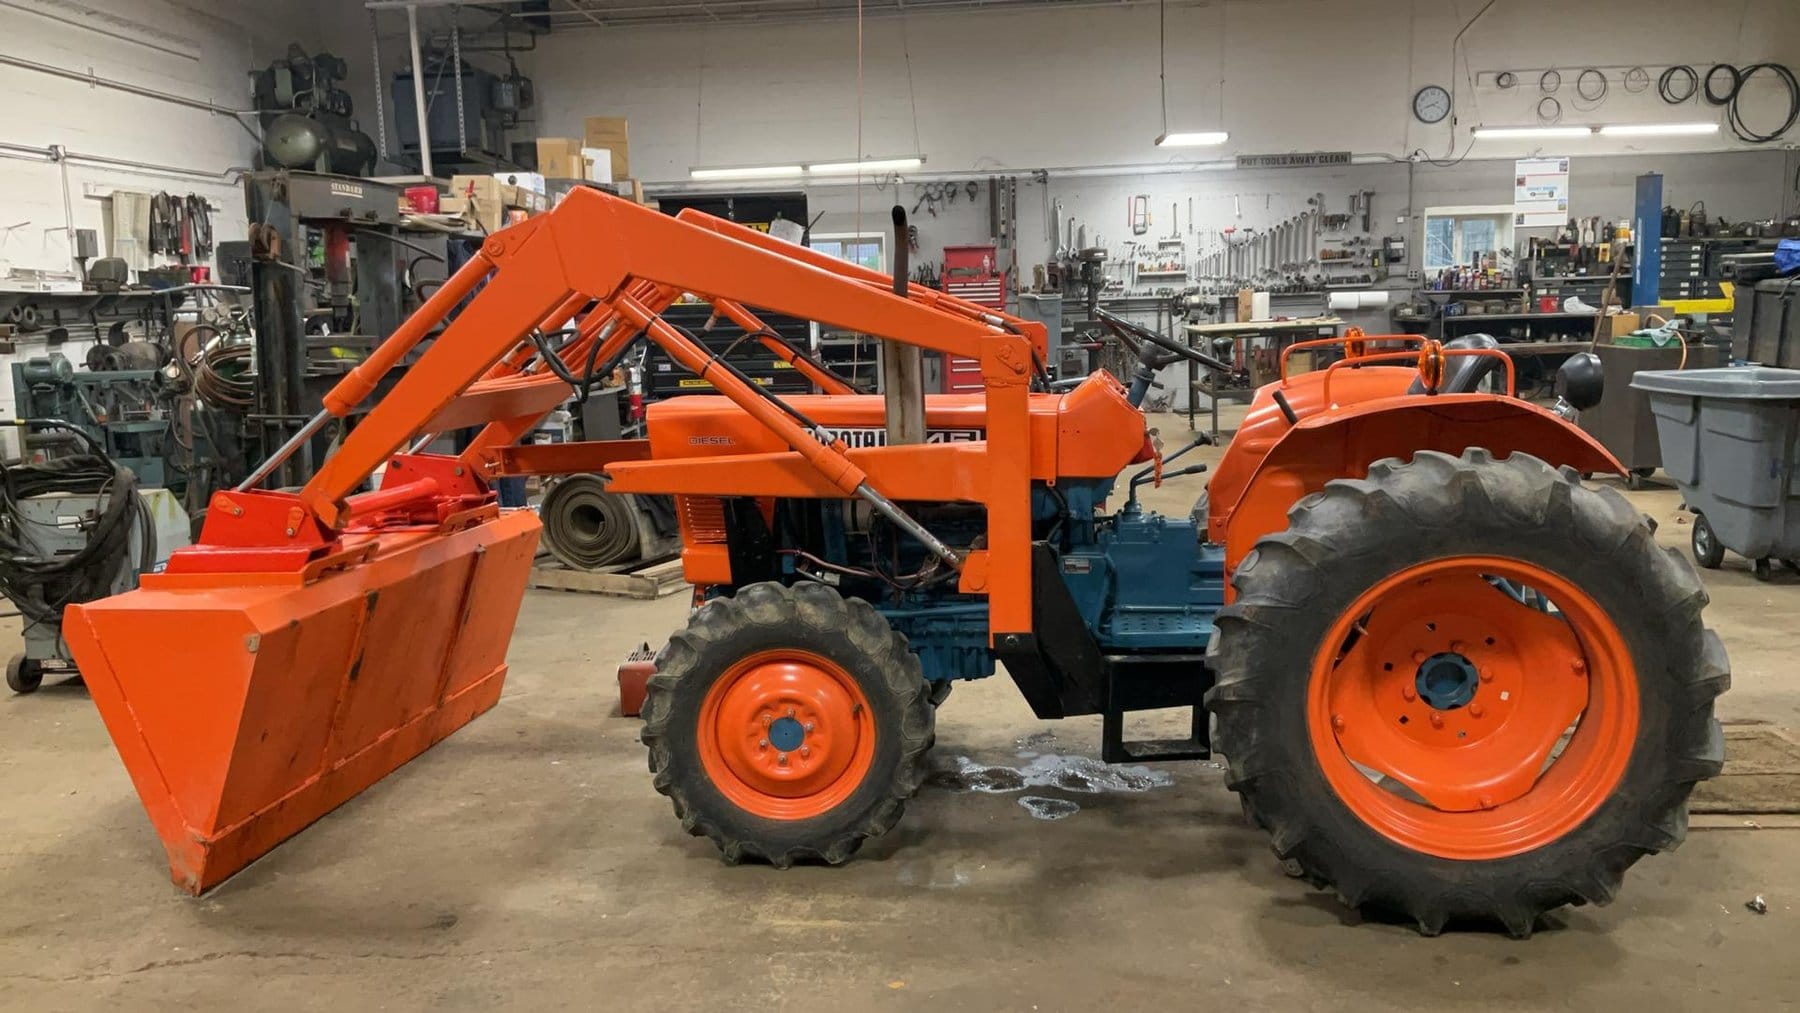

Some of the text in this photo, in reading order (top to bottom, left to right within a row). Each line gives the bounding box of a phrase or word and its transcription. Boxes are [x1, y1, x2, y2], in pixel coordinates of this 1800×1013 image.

[1241, 155, 1348, 166] PUT TOOLS AWAY CLEAN
[688, 436, 735, 446] DIESEL
